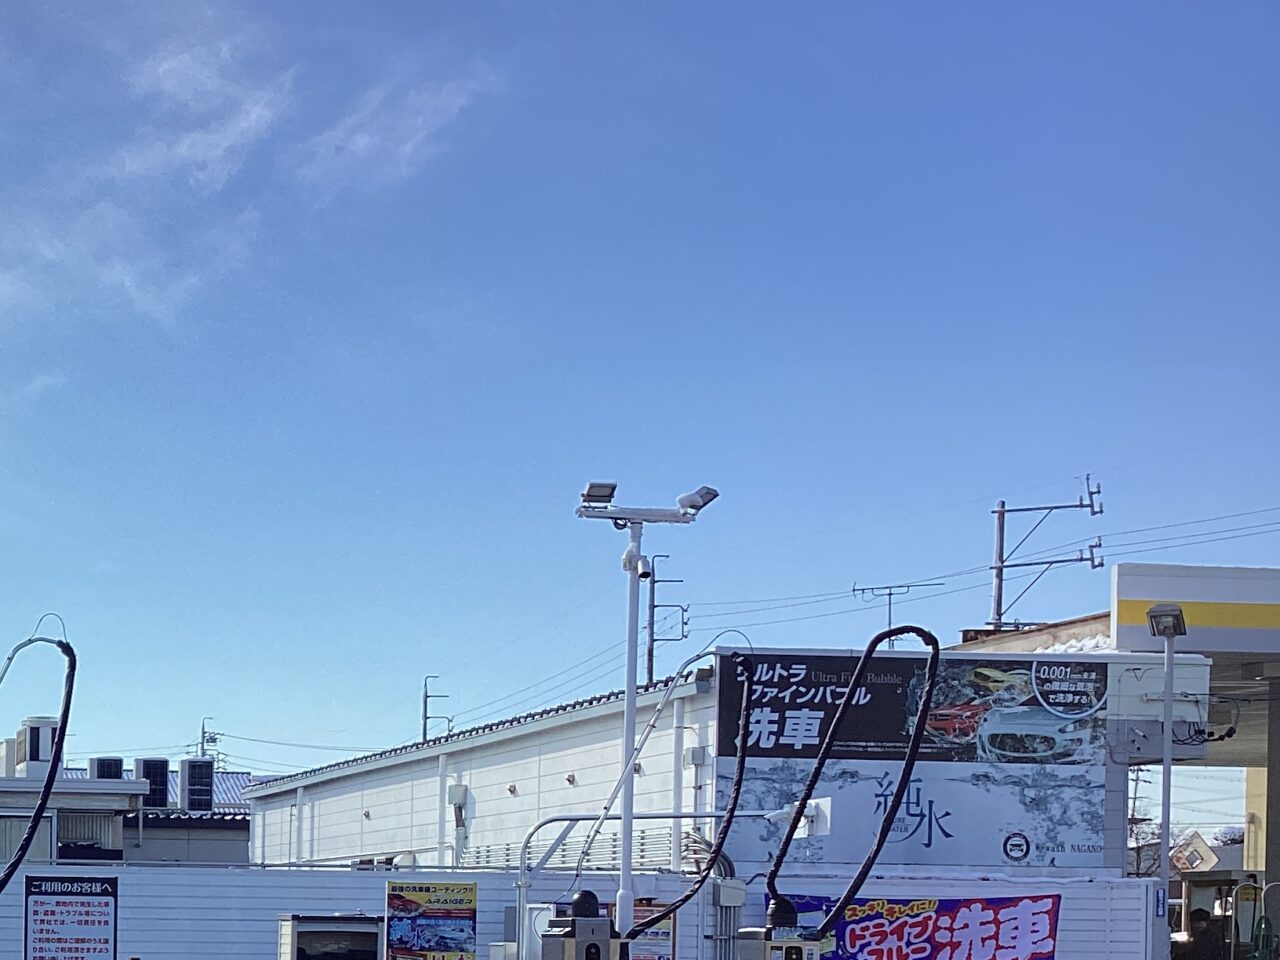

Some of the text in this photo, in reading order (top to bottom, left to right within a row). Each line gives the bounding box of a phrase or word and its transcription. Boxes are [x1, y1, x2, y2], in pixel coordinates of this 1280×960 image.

[736, 663, 807, 682] ルトラ
[812, 672, 837, 682] Ultra
[866, 673, 902, 684] Bubble
[1070, 845, 1102, 853] NAGANO
[31, 882, 112, 893] ご利用のお客様へ
[847, 914, 935, 952] ドライブ
